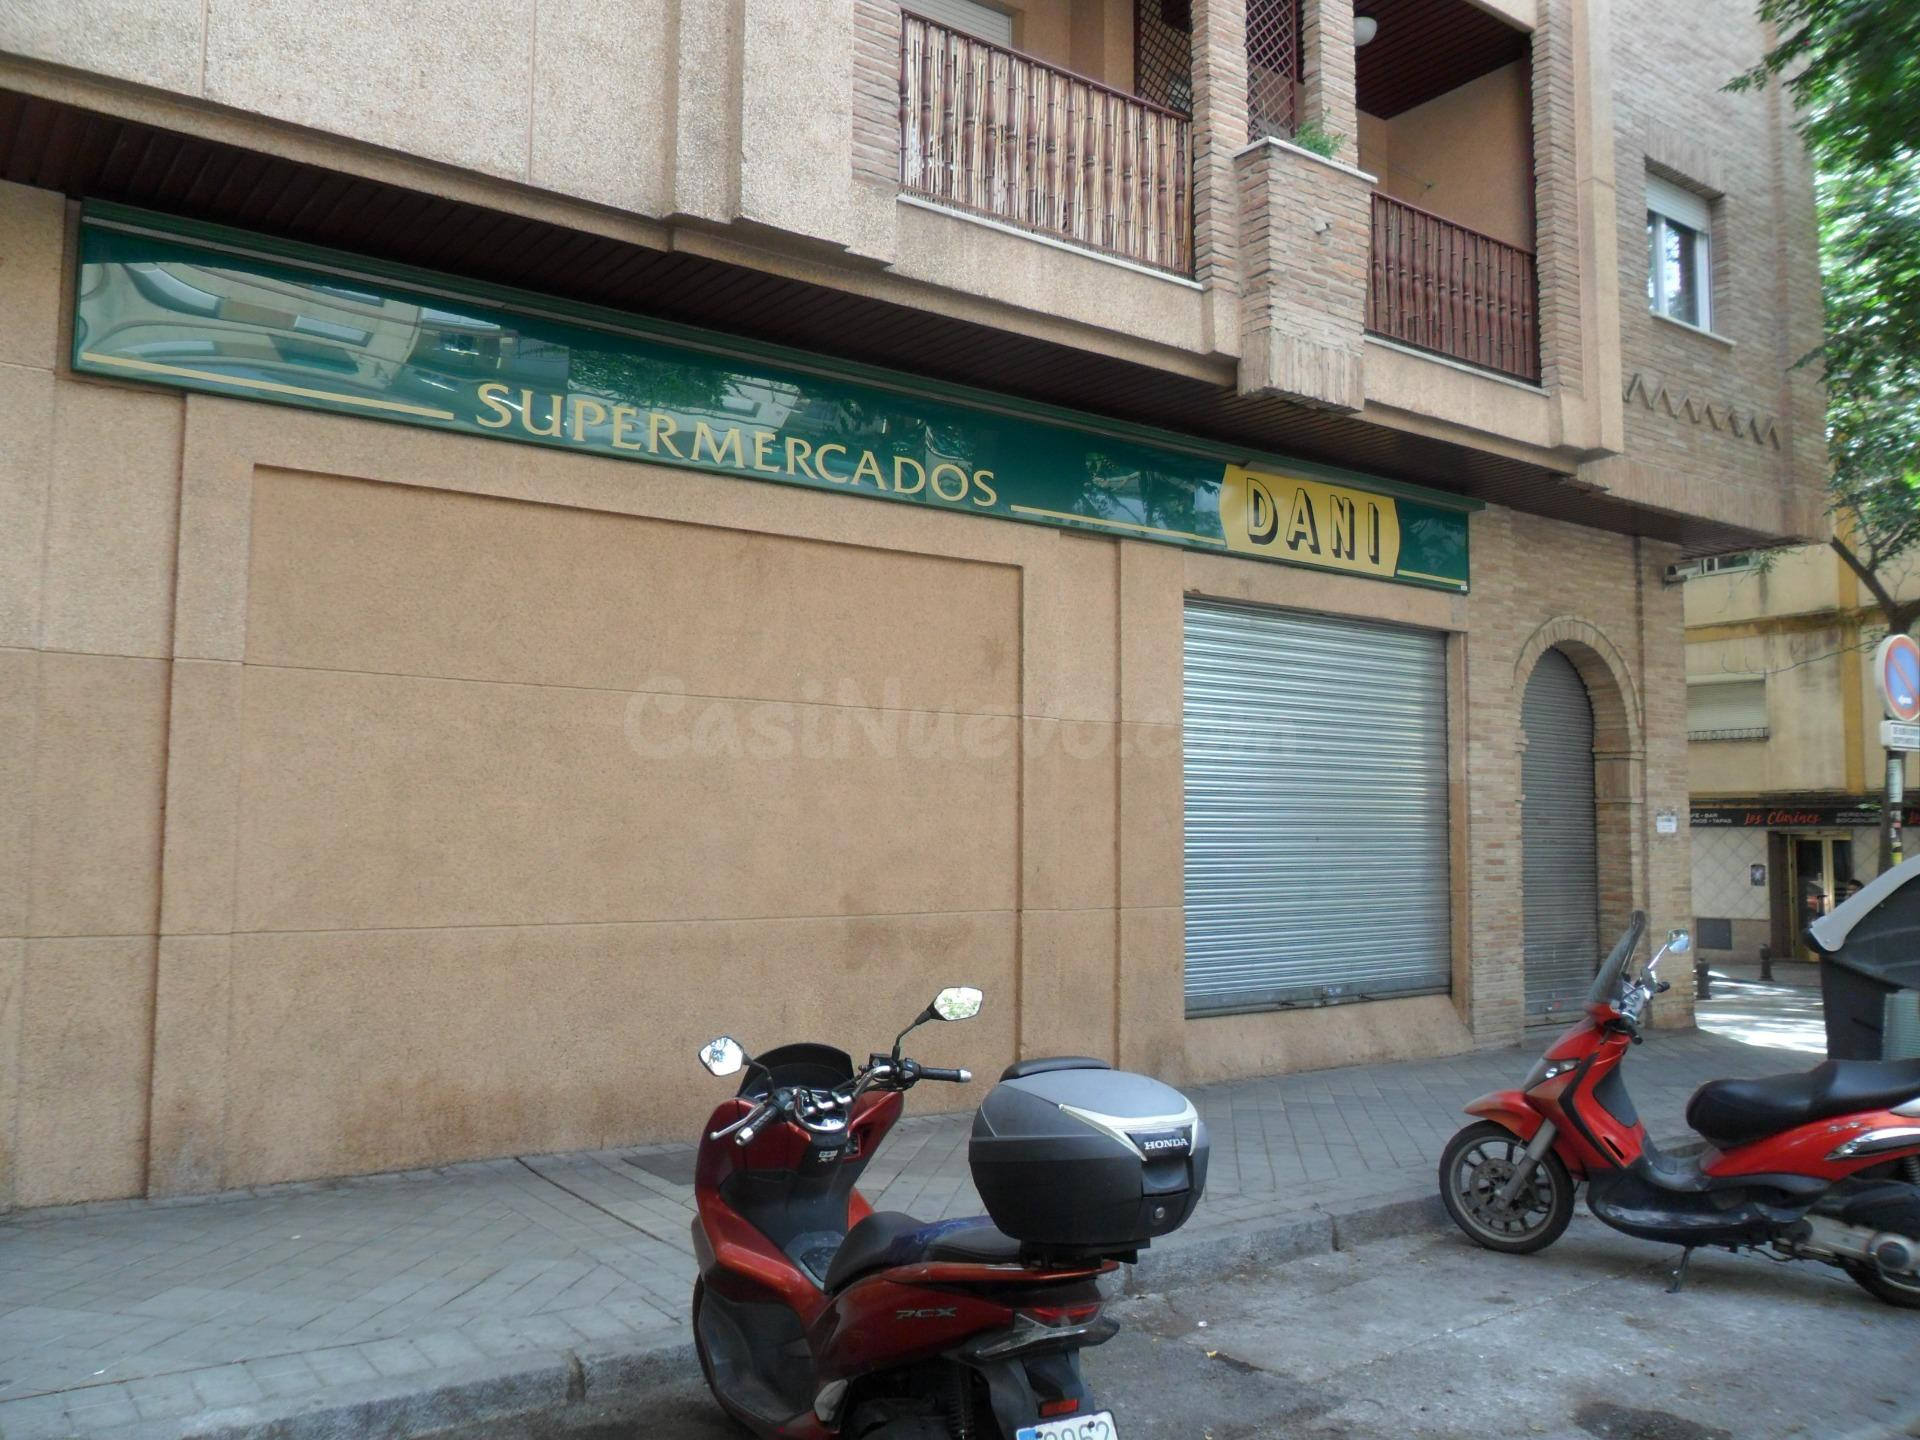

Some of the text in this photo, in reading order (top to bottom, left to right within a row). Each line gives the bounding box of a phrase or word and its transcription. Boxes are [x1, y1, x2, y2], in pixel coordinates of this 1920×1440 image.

[475, 382, 998, 507] SUPERMERCADOS
[1246, 477, 1380, 565] DANI
[1144, 1138, 1188, 1150] HONDA
